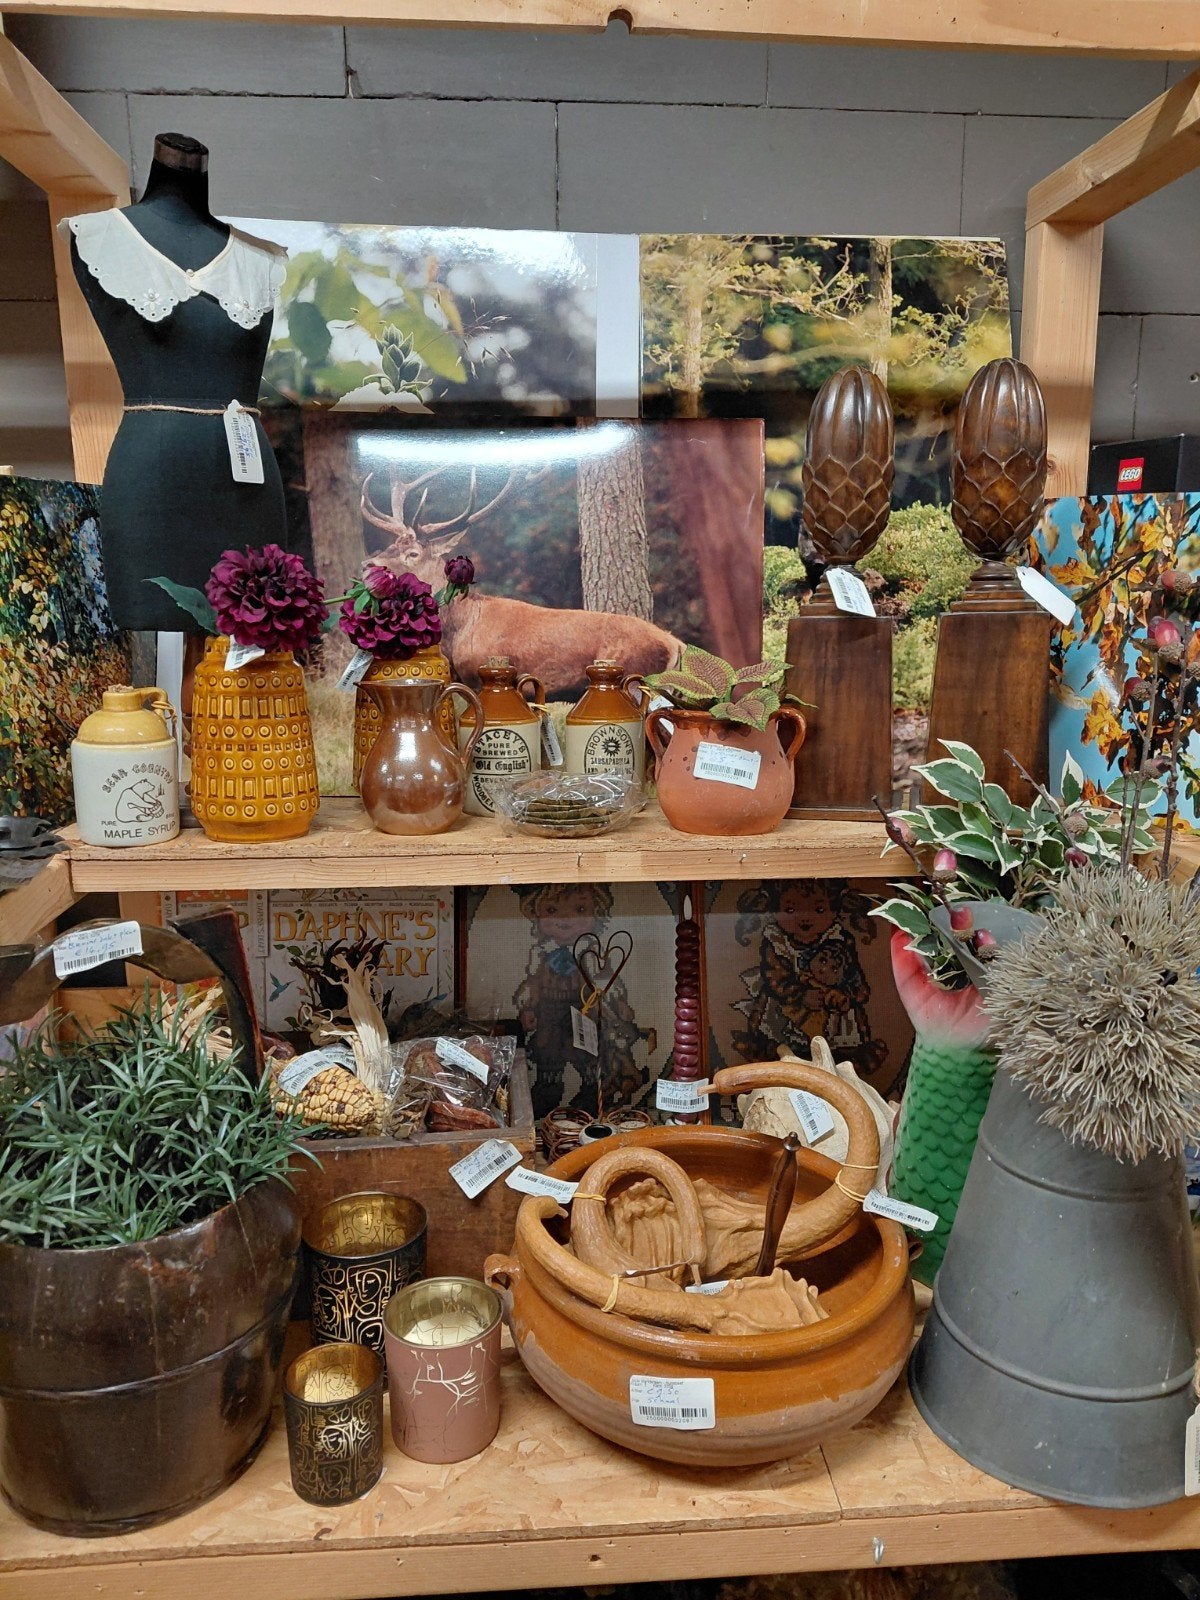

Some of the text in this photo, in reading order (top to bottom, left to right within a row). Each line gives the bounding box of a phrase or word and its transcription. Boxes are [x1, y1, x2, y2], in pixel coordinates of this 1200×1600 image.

[1120, 467, 1142, 481] LEGO
[474, 730, 527, 754] STACEY'S
[587, 726, 633, 756] BROWNSON'S
[101, 763, 174, 794] BEAR COUNTRY
[104, 820, 176, 839] MAPLE SYRUP
[273, 910, 437, 942] DAPHNE'S
[375, 946, 436, 978] ARY
